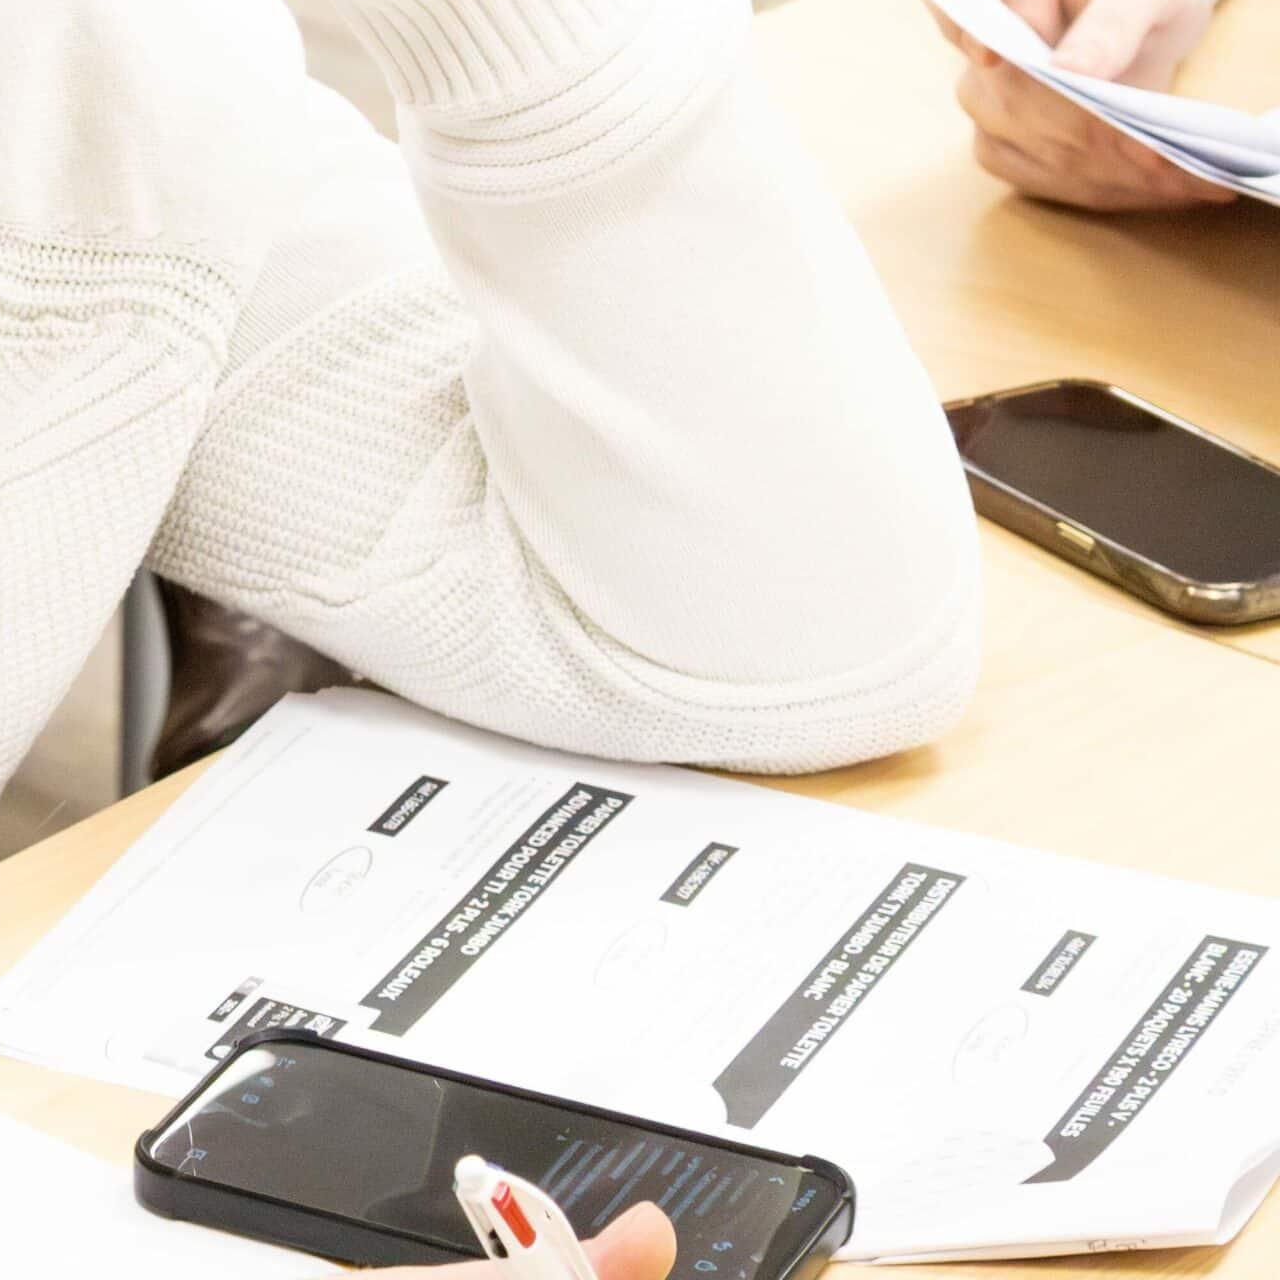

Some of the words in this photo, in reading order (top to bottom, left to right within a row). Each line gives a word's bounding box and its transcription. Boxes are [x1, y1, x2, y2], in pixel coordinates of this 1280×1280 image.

[527, 789, 593, 847] ADVANCED
[574, 797, 623, 835] PAPIER
[495, 845, 538, 881] POUR
[527, 833, 587, 886] TOILETTE
[497, 885, 540, 918] TORK
[887, 871, 928, 904] TORK
[445, 906, 481, 934] PLIS
[460, 914, 510, 956] JUMBO
[843, 913, 891, 955] JUMBO
[877, 877, 957, 957] DISTRIBUTEUR
[803, 959, 850, 1001] BLANC
[861, 954, 891, 975] DE
[1184, 942, 1228, 983] BLANC
[825, 971, 876, 1017] PAPIER
[1167, 987, 1193, 1004] 20
[780, 1015, 840, 1069] TOILETTE
[1126, 1002, 1181, 1057] PAQUETS
[1150, 1025, 1200, 1071] LYRECO
[1059, 1085, 1116, 1138] FEUILLES
[1117, 1085, 1152, 1111] PLIS
